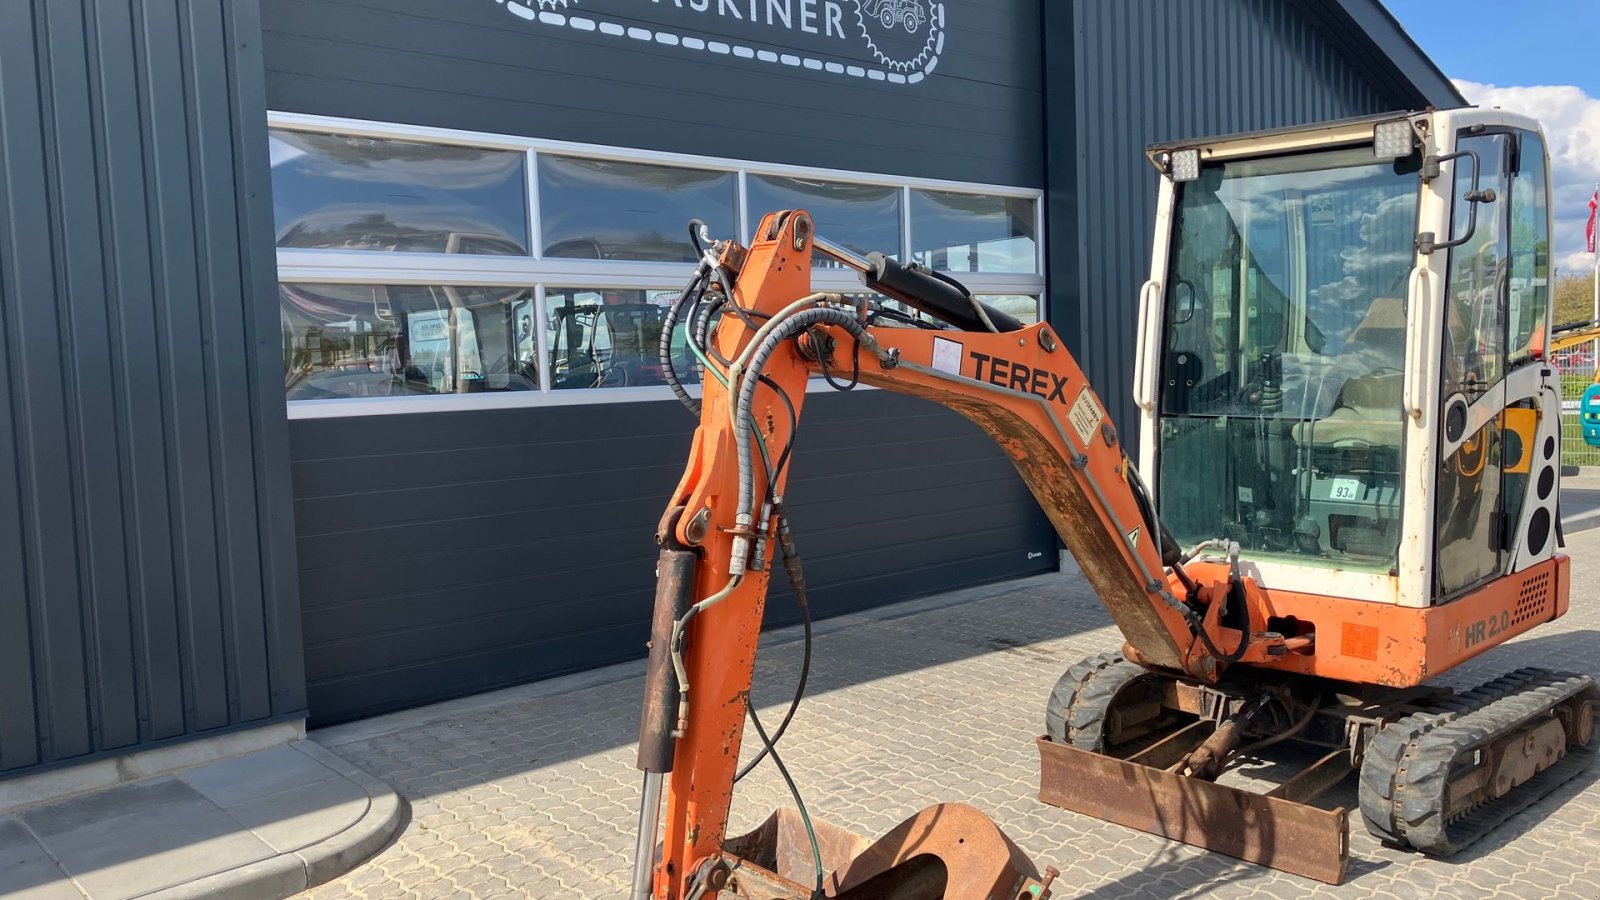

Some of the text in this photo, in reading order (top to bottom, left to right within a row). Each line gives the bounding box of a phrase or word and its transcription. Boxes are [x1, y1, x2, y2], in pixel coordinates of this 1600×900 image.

[652, 0, 846, 39] INER
[970, 351, 1069, 405] TEREX
[1336, 486, 1349, 498] 93
[1465, 610, 1509, 649] HR 2.0
